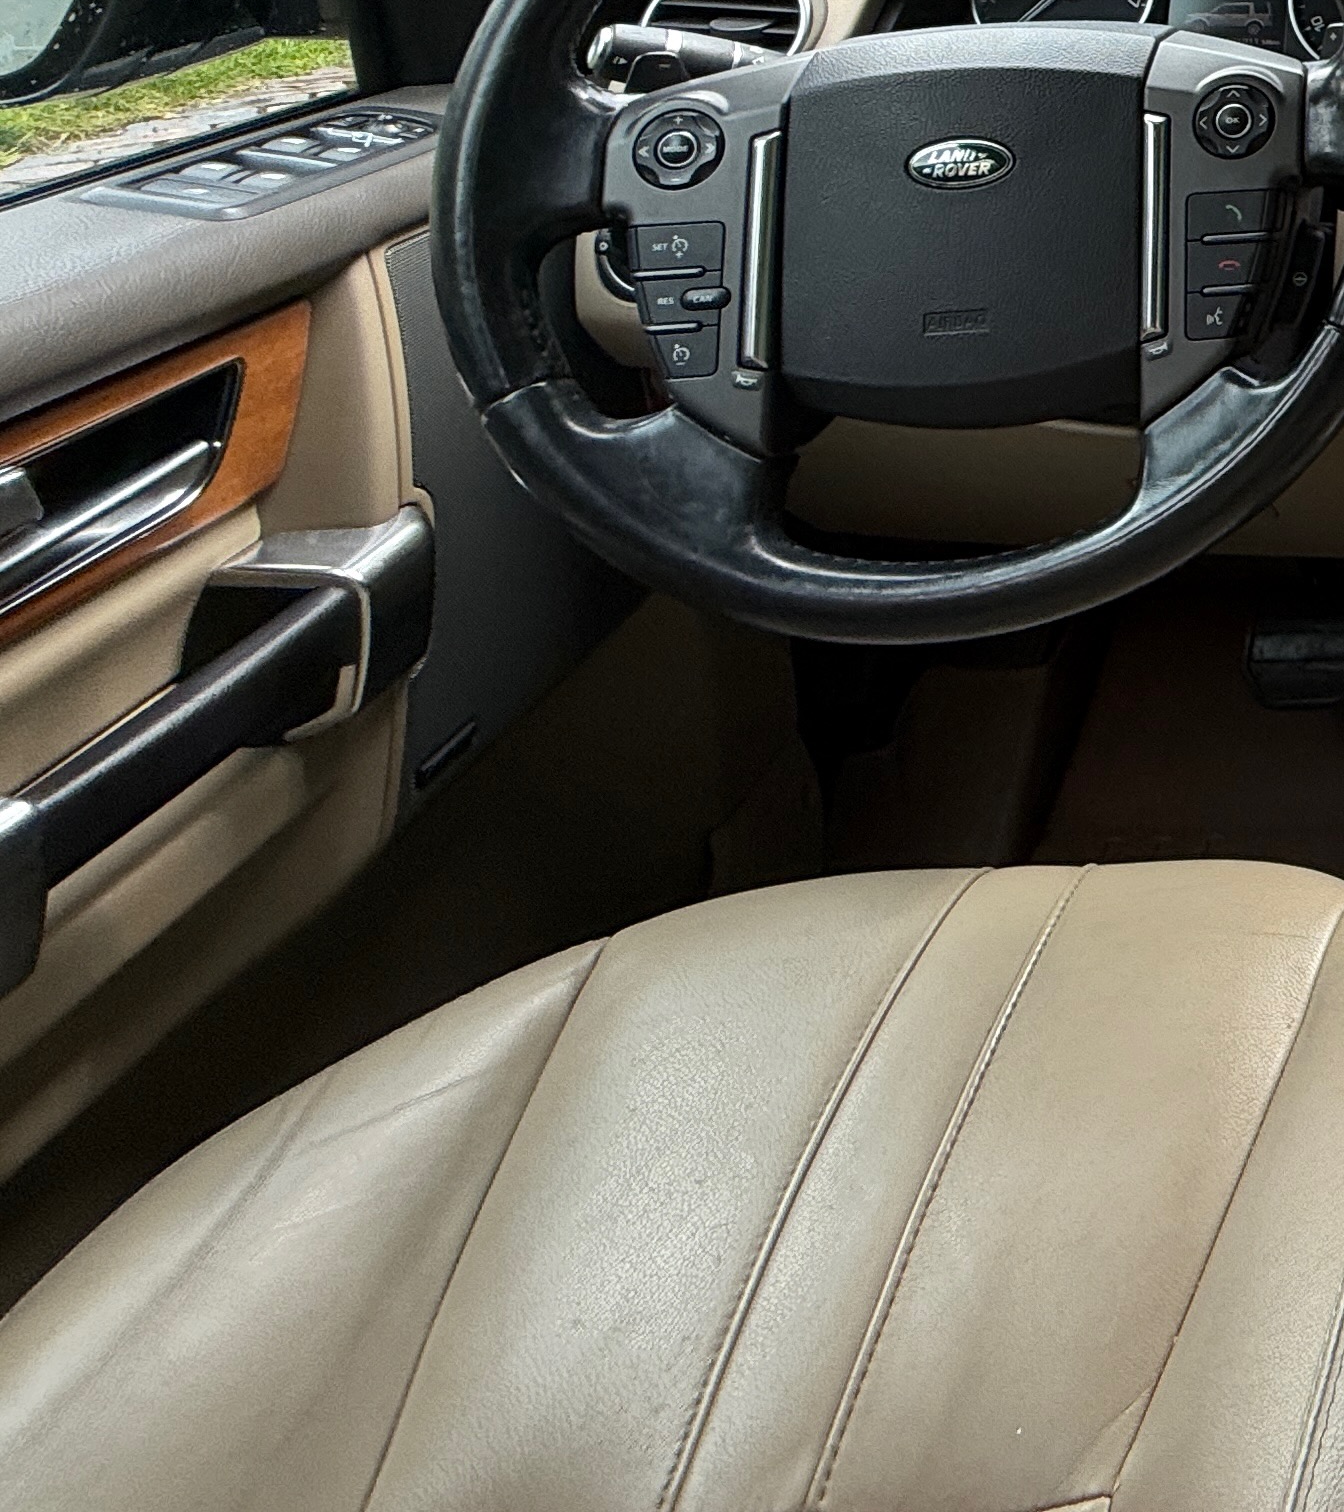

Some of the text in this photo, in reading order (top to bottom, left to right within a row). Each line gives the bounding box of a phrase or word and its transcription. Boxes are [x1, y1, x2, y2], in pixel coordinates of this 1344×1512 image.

[1310, 15, 1325, 32] 10
[1225, 116, 1240, 124] OK
[928, 148, 977, 163] LAND
[932, 161, 991, 178] ROVER
[651, 242, 669, 252] SET
[656, 296, 675, 305] RES
[692, 294, 713, 304] CAN
[927, 314, 987, 329] AIRBAG
